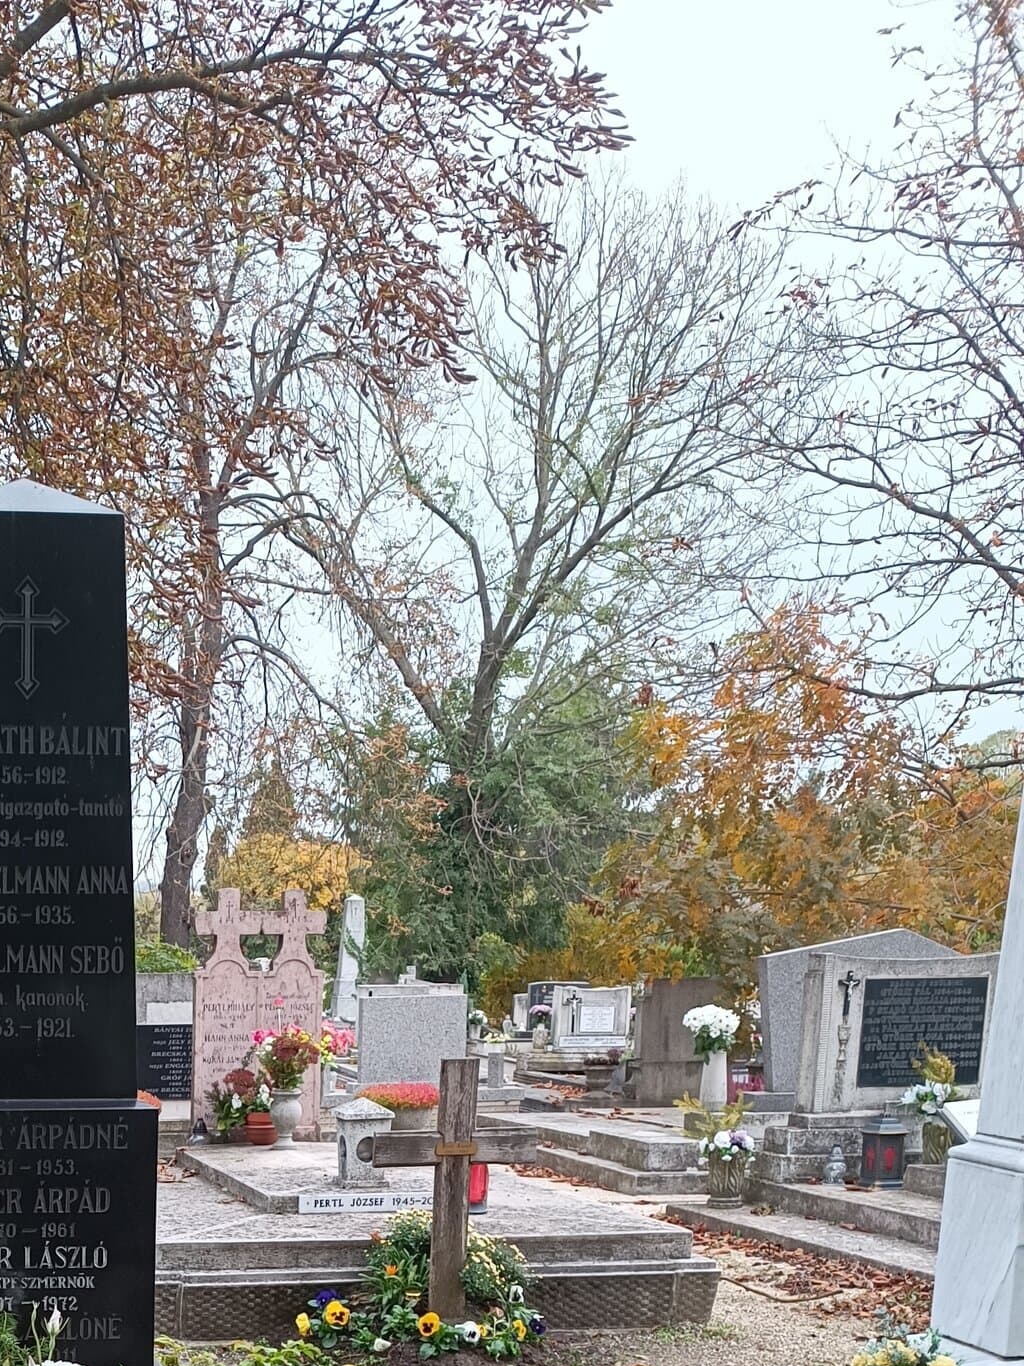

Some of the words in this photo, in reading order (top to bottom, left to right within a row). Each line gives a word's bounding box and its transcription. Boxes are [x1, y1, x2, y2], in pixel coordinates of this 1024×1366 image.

[39, 712, 126, 756] BÁLINT
[76, 865, 129, 895] ANNA
[16, 1116, 129, 1150] ÁRPÁDNÉ
[33, 1179, 111, 1214] ÁRPÁD
[314, 1199, 344, 1208] PERTL
[350, 1196, 385, 1207] JÓZSEF
[24, 1240, 109, 1270] LÁSZLÓ
